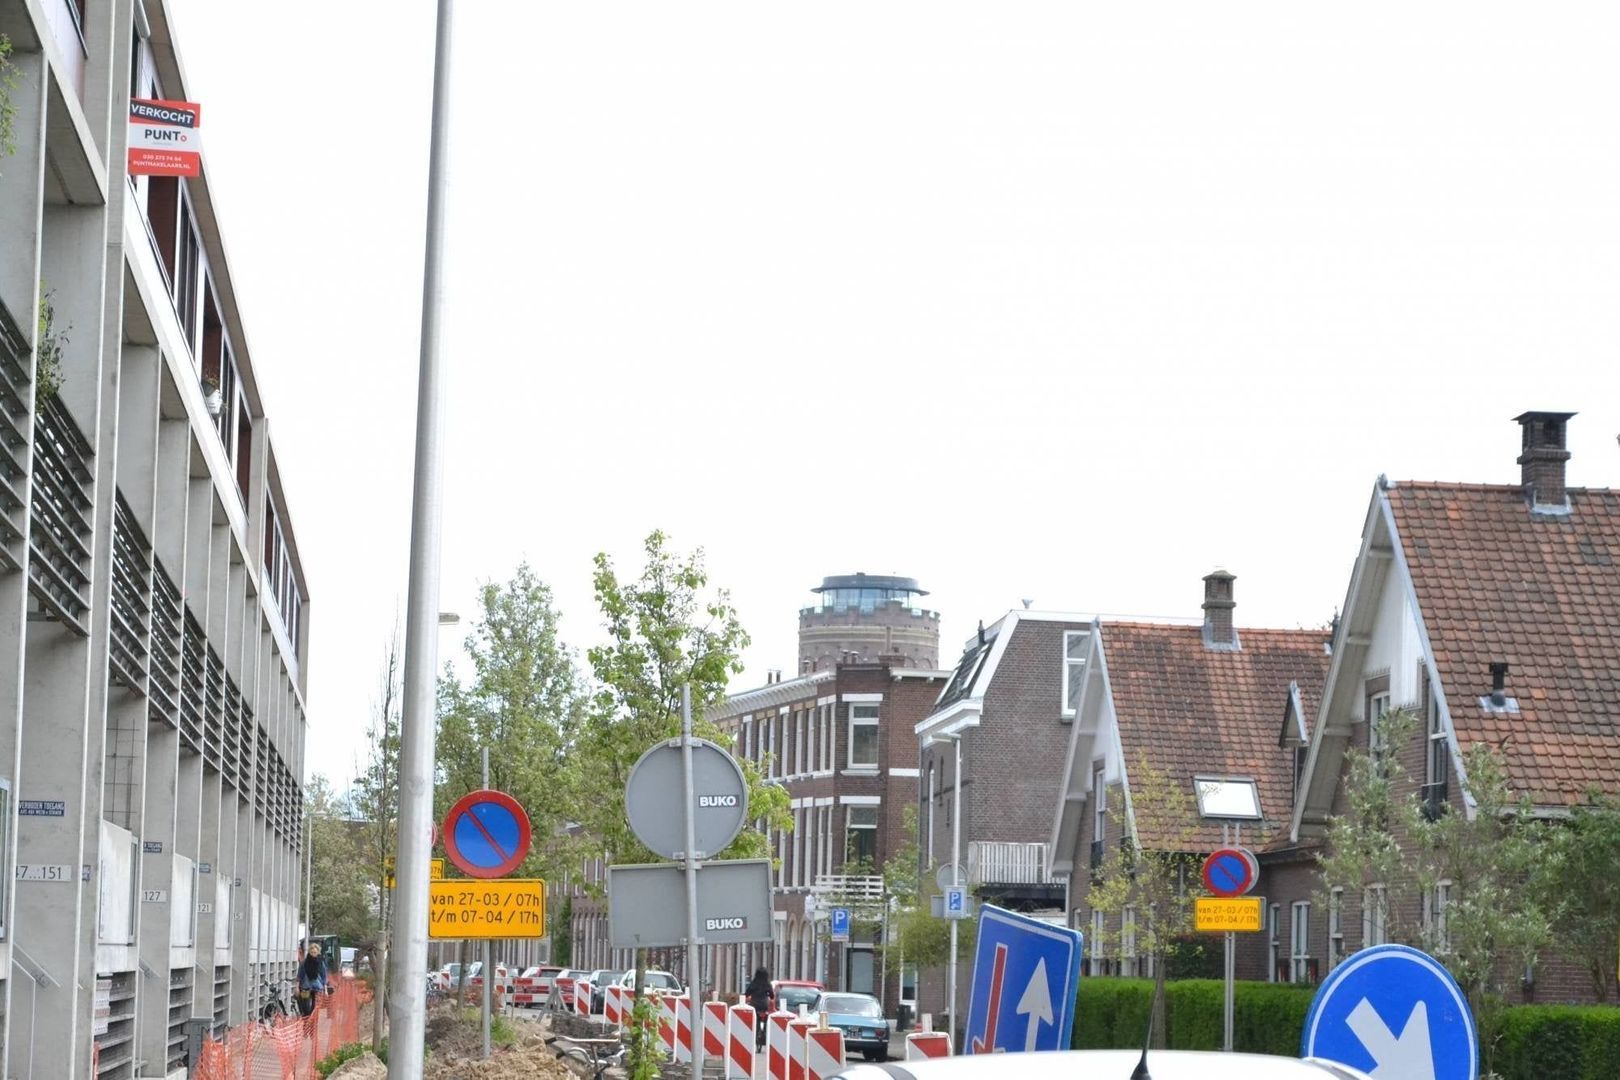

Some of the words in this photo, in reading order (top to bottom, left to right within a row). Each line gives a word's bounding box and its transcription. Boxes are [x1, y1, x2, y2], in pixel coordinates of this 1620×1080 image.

[131, 104, 193, 124] VERKOCHT
[700, 796, 736, 806] BUKO
[144, 891, 160, 900] 127
[431, 894, 454, 905] van
[459, 892, 499, 906] 27-03
[504, 893, 512, 906] /
[516, 893, 540, 906] 07h
[198, 904, 209, 912] 121
[1213, 906, 1236, 914] 27-03
[431, 910, 456, 924] t/m
[461, 910, 503, 923] 07-04
[507, 910, 516, 924] /
[520, 911, 539, 924] 17h
[706, 918, 743, 930] BUKO
